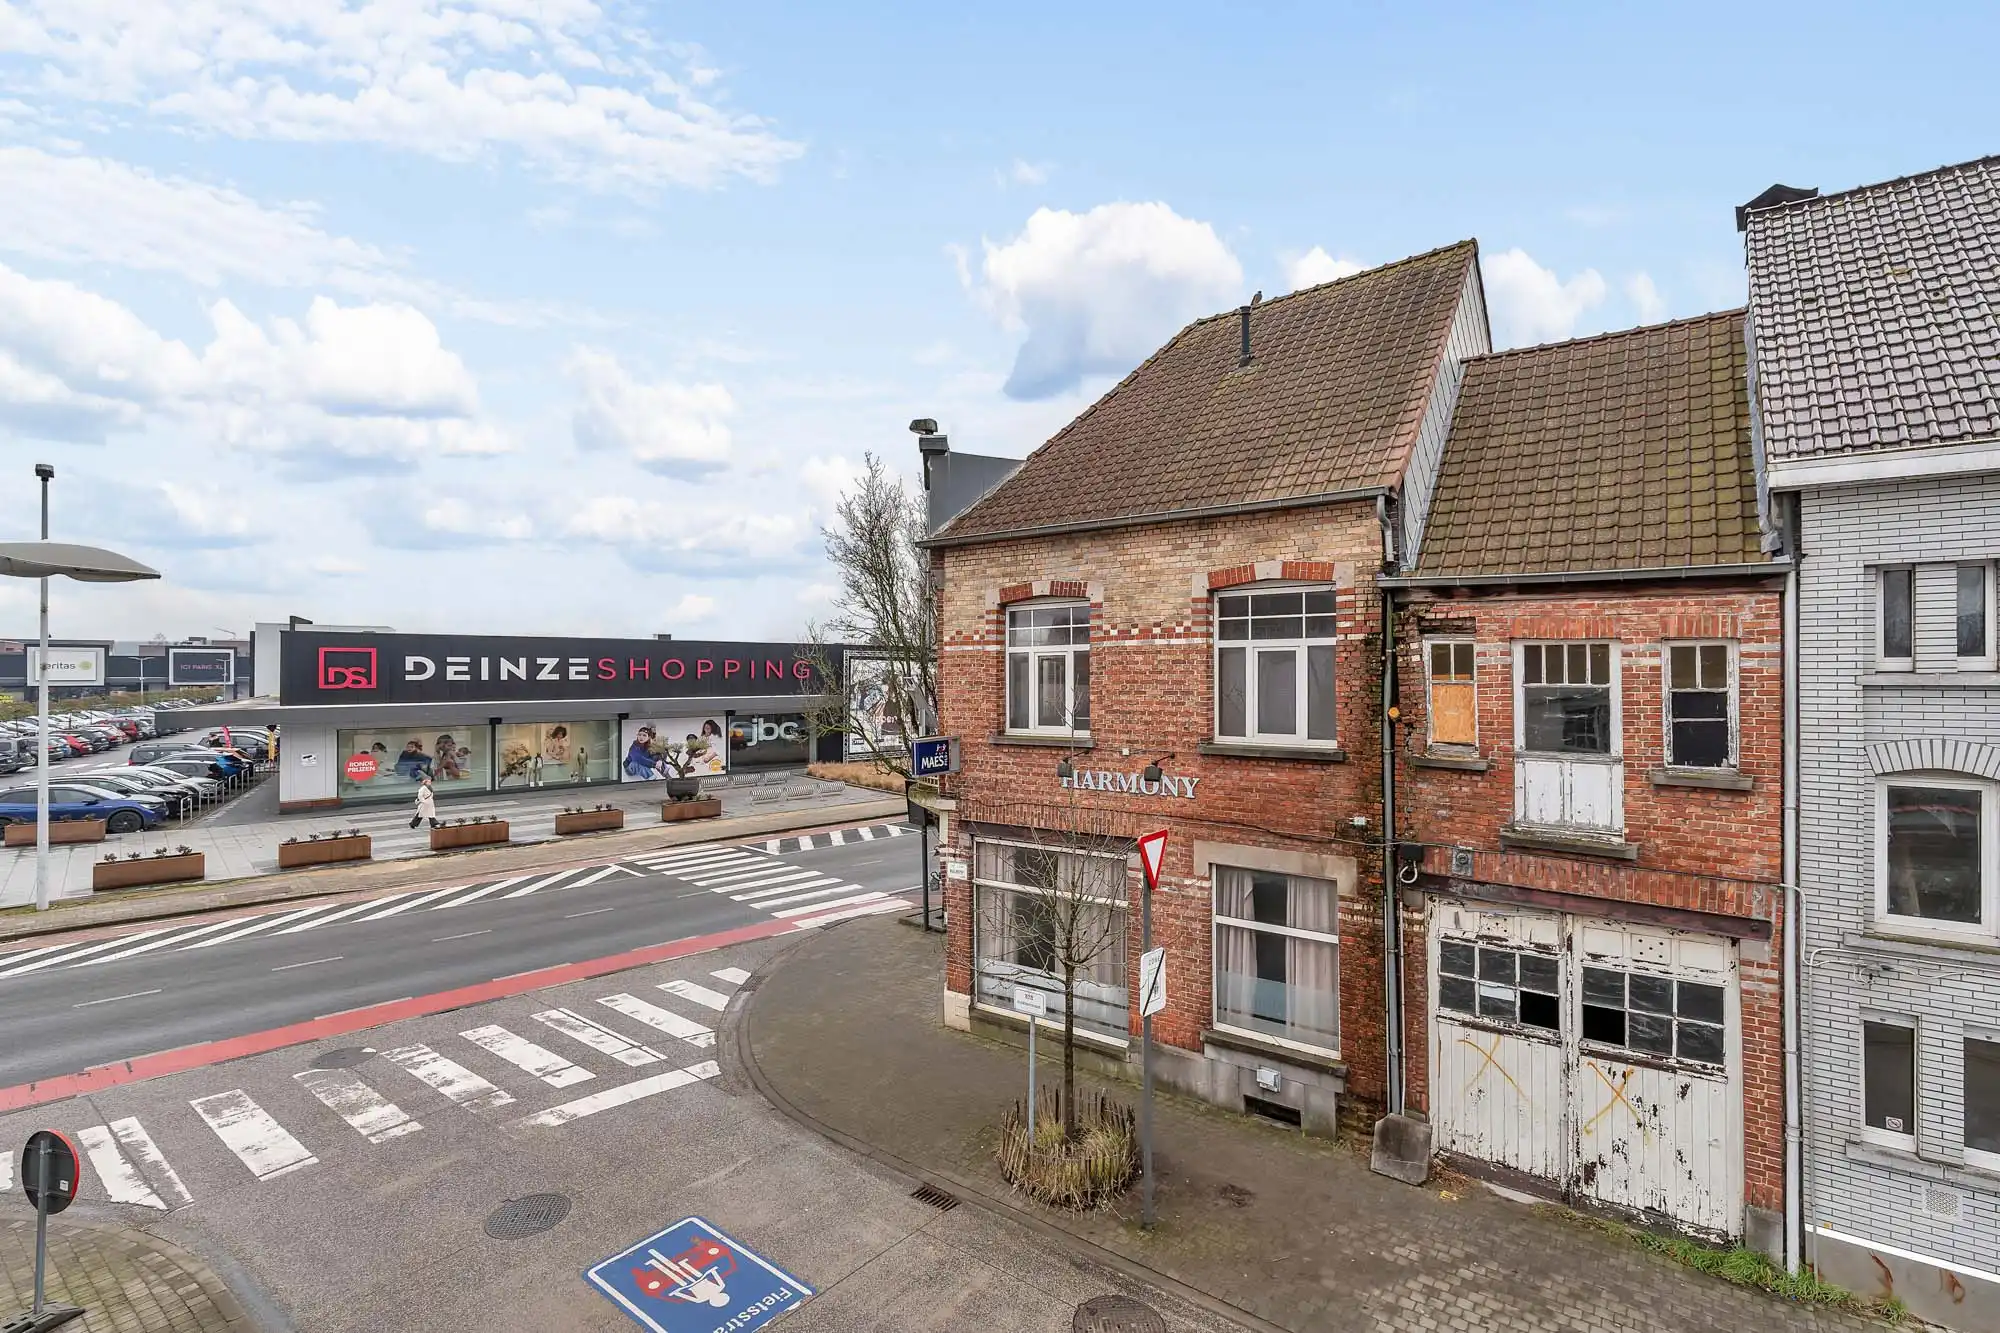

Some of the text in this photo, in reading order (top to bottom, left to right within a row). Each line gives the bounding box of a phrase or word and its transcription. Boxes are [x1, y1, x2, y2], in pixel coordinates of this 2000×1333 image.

[405, 656, 812, 681] DEINZE SHOPPING
[746, 718, 800, 747] jbc
[921, 755, 945, 769] MAES
[1062, 769, 1200, 799] HARMONY
